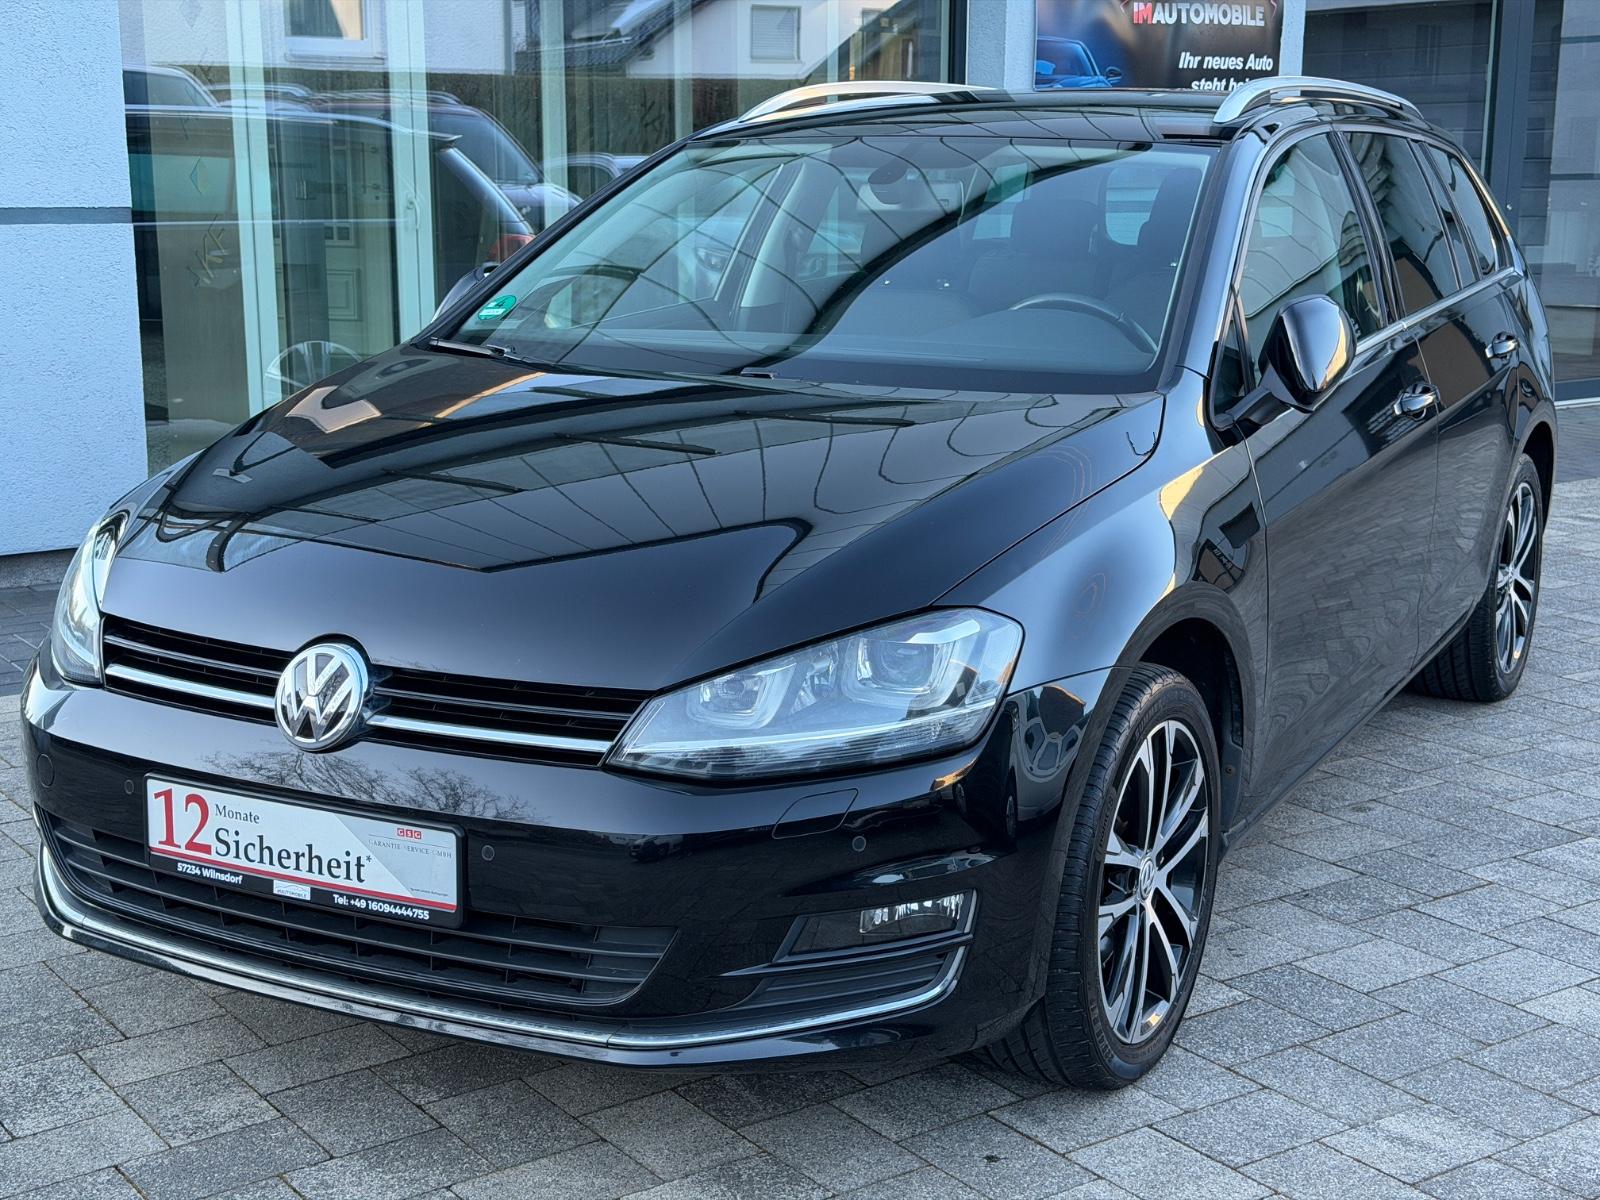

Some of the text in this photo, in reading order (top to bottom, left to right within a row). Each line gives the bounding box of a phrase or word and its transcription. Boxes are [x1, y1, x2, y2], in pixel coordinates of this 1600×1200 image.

[1133, 2, 1265, 26] IMAUTOMOBILE
[1179, 51, 1273, 71] Ihr neues Auto
[1191, 77, 1226, 90] steht
[154, 788, 212, 855] 12
[215, 803, 260, 824] Monate
[404, 844, 430, 855] ERVICE
[177, 862, 243, 884] 57234 Wilnsdorf
[333, 894, 430, 920] Tel: +49 16094444755
